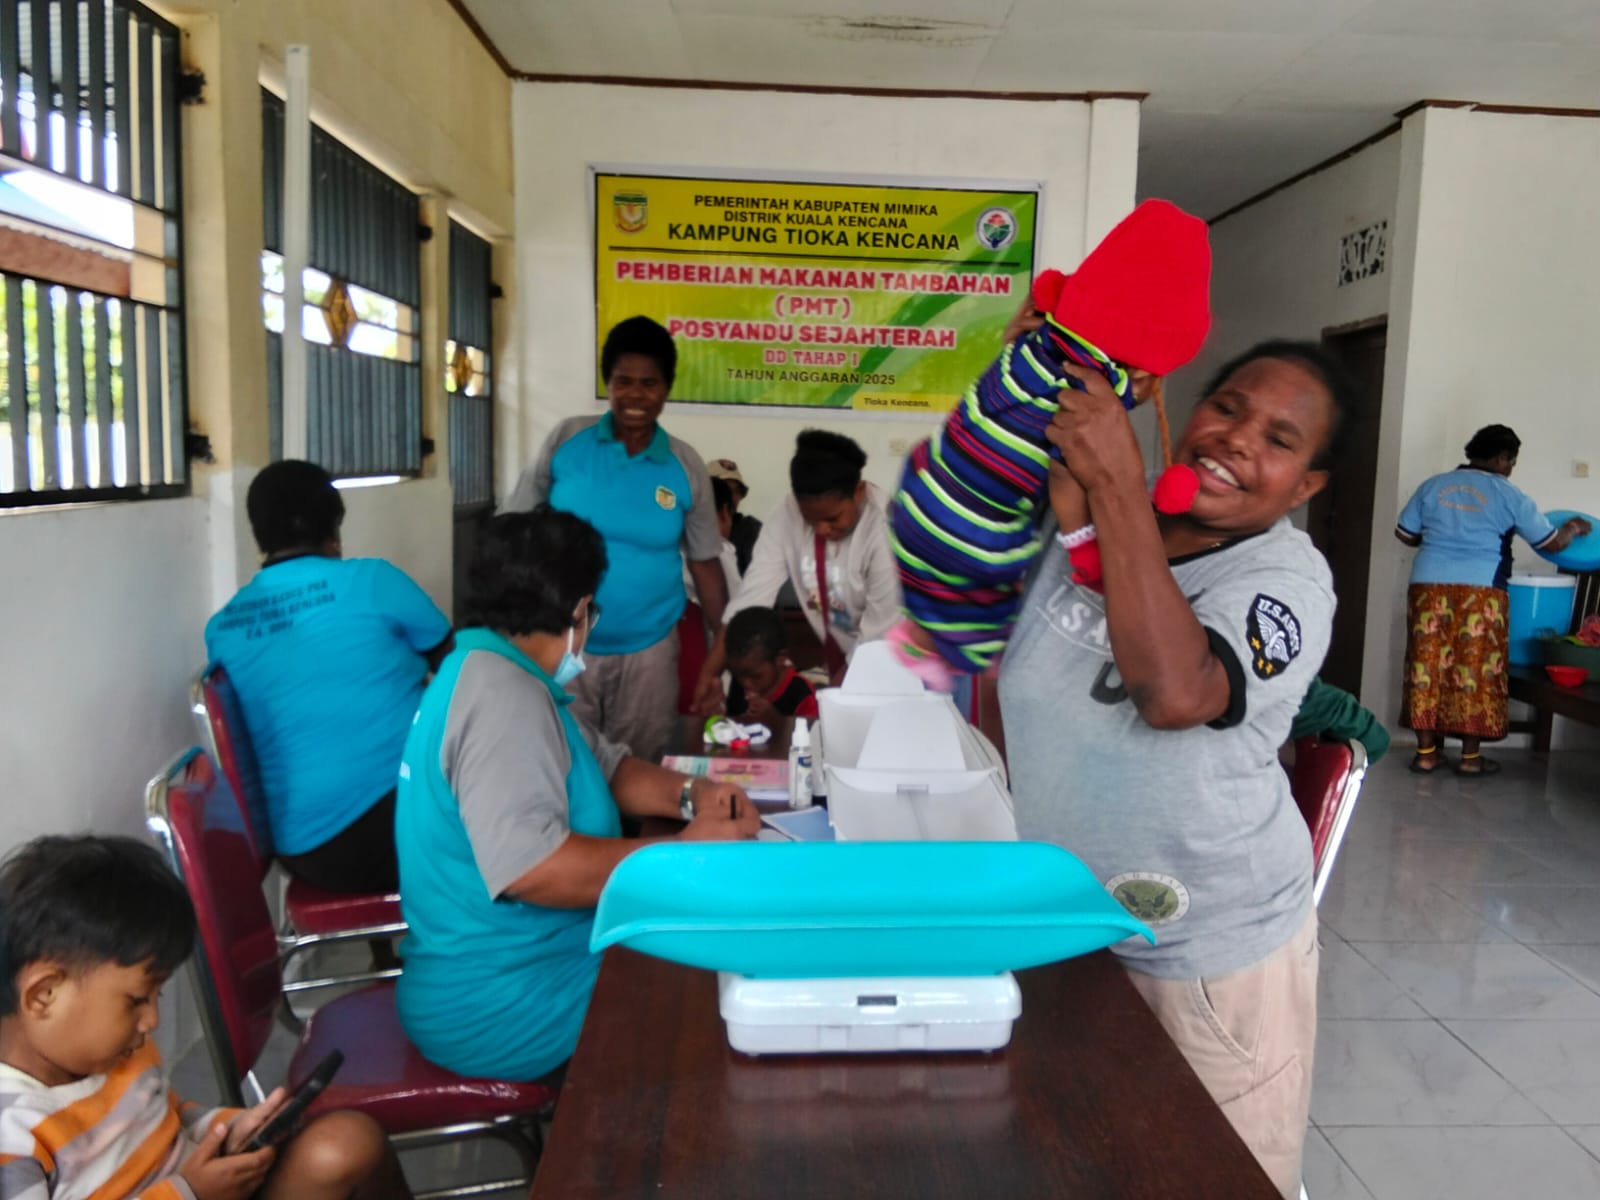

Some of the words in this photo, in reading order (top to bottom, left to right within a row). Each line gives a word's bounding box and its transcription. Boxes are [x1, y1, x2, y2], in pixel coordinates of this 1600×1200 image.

[694, 195, 788, 210] PEMERINTAH
[794, 199, 880, 214] KABUPATEN
[884, 203, 938, 216] MIMIKA
[724, 210, 781, 224] DISTRIK
[786, 213, 833, 226] KUALA
[838, 215, 908, 229] KENCANA
[668, 223, 777, 243] KAMPUNG
[784, 228, 849, 246] TIOKA
[857, 231, 960, 250] KENCANA
[617, 261, 753, 284] PEMBERIAN
[760, 267, 875, 289] MAKANAN
[881, 272, 1010, 294] TAMBAHAN
[669, 319, 793, 342] POSYANDU
[799, 325, 955, 347] SEJAHTERAH
[764, 349, 787, 363] DD
[792, 351, 847, 366] TAHAP
[727, 368, 774, 381] TAHUN
[779, 370, 860, 384] ANGGARAN
[864, 374, 895, 385] 2025
[864, 397, 888, 406] Tioka
